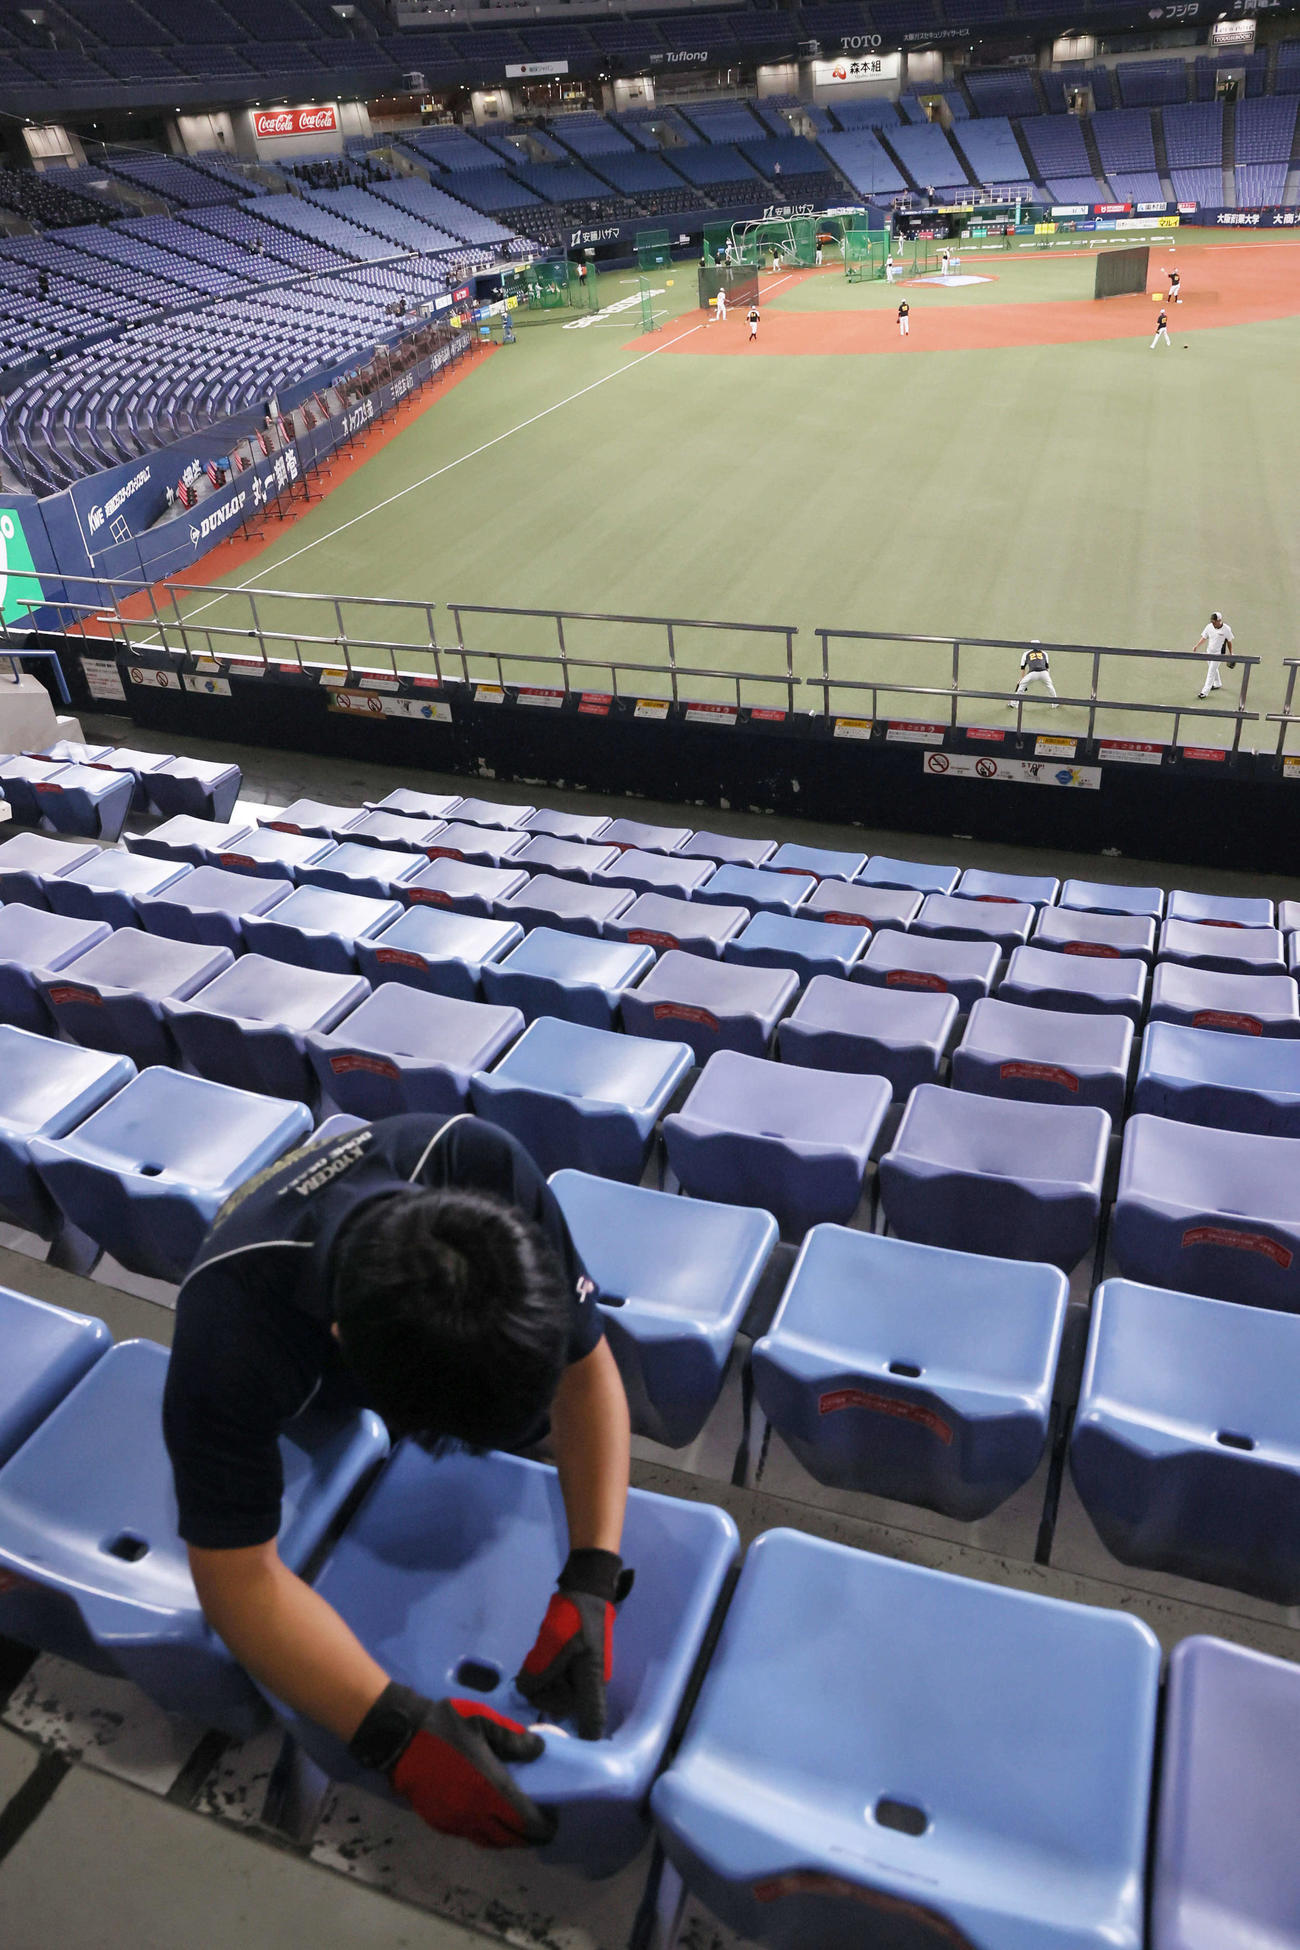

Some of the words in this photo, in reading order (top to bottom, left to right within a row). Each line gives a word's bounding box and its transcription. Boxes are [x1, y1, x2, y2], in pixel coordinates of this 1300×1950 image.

[1166, 3, 1198, 19] フジタ
[841, 34, 882, 49] TOTO
[666, 51, 708, 63] Tuflong
[850, 60, 881, 74] 森本組
[583, 227, 620, 242] 安藤ハザマ
[88, 505, 105, 536] KWE
[200, 491, 246, 538] DUNLOP
[328, 1130, 373, 1158] DOME
[296, 1145, 364, 1196] KYOCERA
